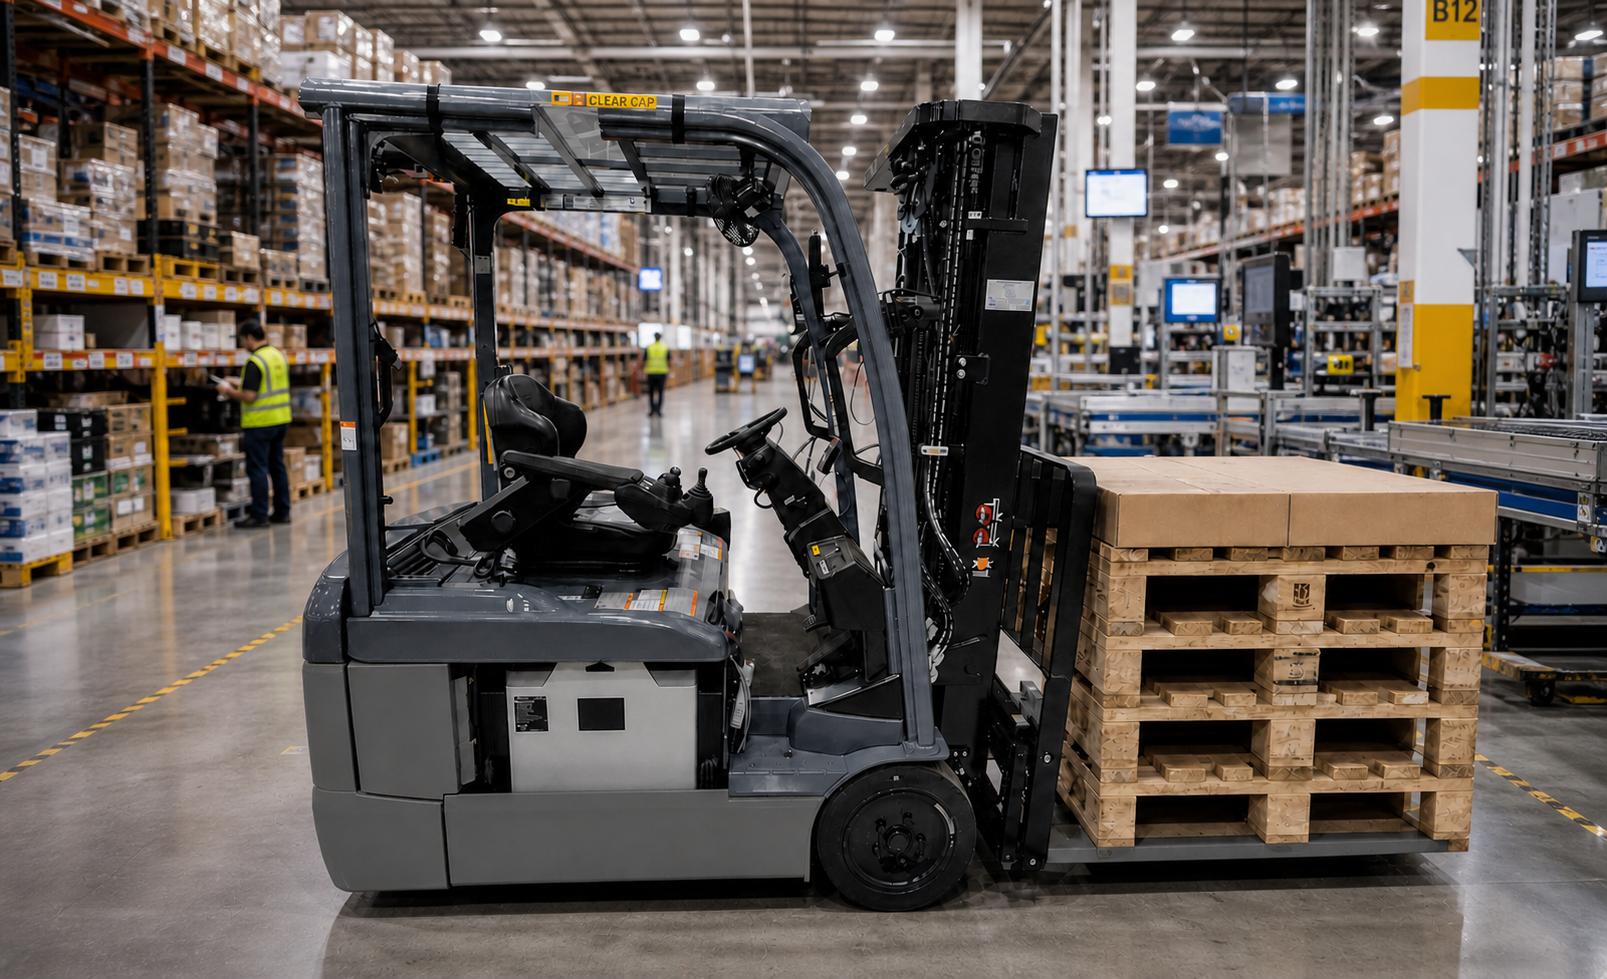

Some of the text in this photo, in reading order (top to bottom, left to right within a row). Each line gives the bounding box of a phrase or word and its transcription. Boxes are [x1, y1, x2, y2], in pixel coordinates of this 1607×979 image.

[1433, 0, 1477, 22] B12
[589, 94, 655, 108] CLEAR CAP
